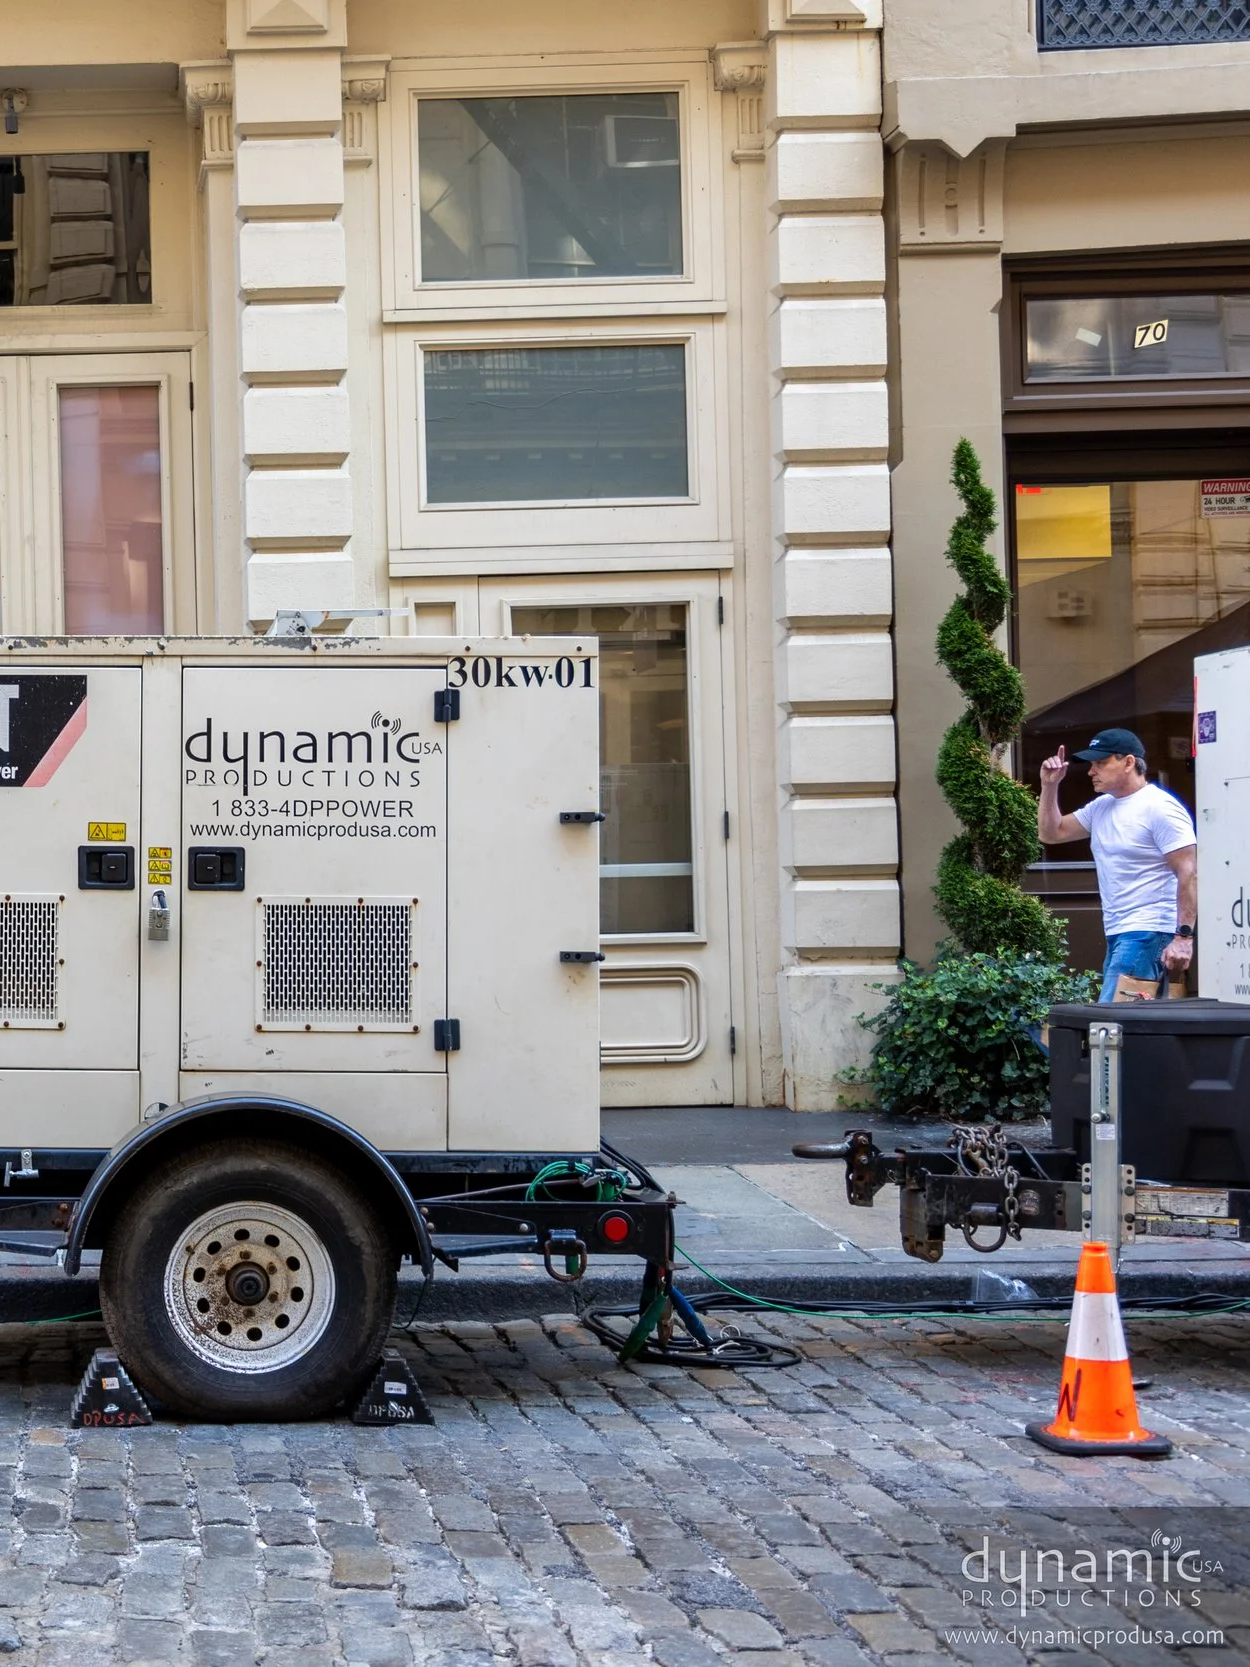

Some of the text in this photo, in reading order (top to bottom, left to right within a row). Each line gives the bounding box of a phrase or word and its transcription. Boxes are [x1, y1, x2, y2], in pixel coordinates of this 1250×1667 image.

[1137, 322, 1166, 346] 70
[1215, 496, 1236, 505] HOUR
[184, 717, 443, 797] dynamic USA
[185, 769, 421, 788] PRODUCTIONS
[212, 799, 414, 818] 1 833-4DPPOWER
[190, 821, 437, 841] www.dynamicprodusa.com
